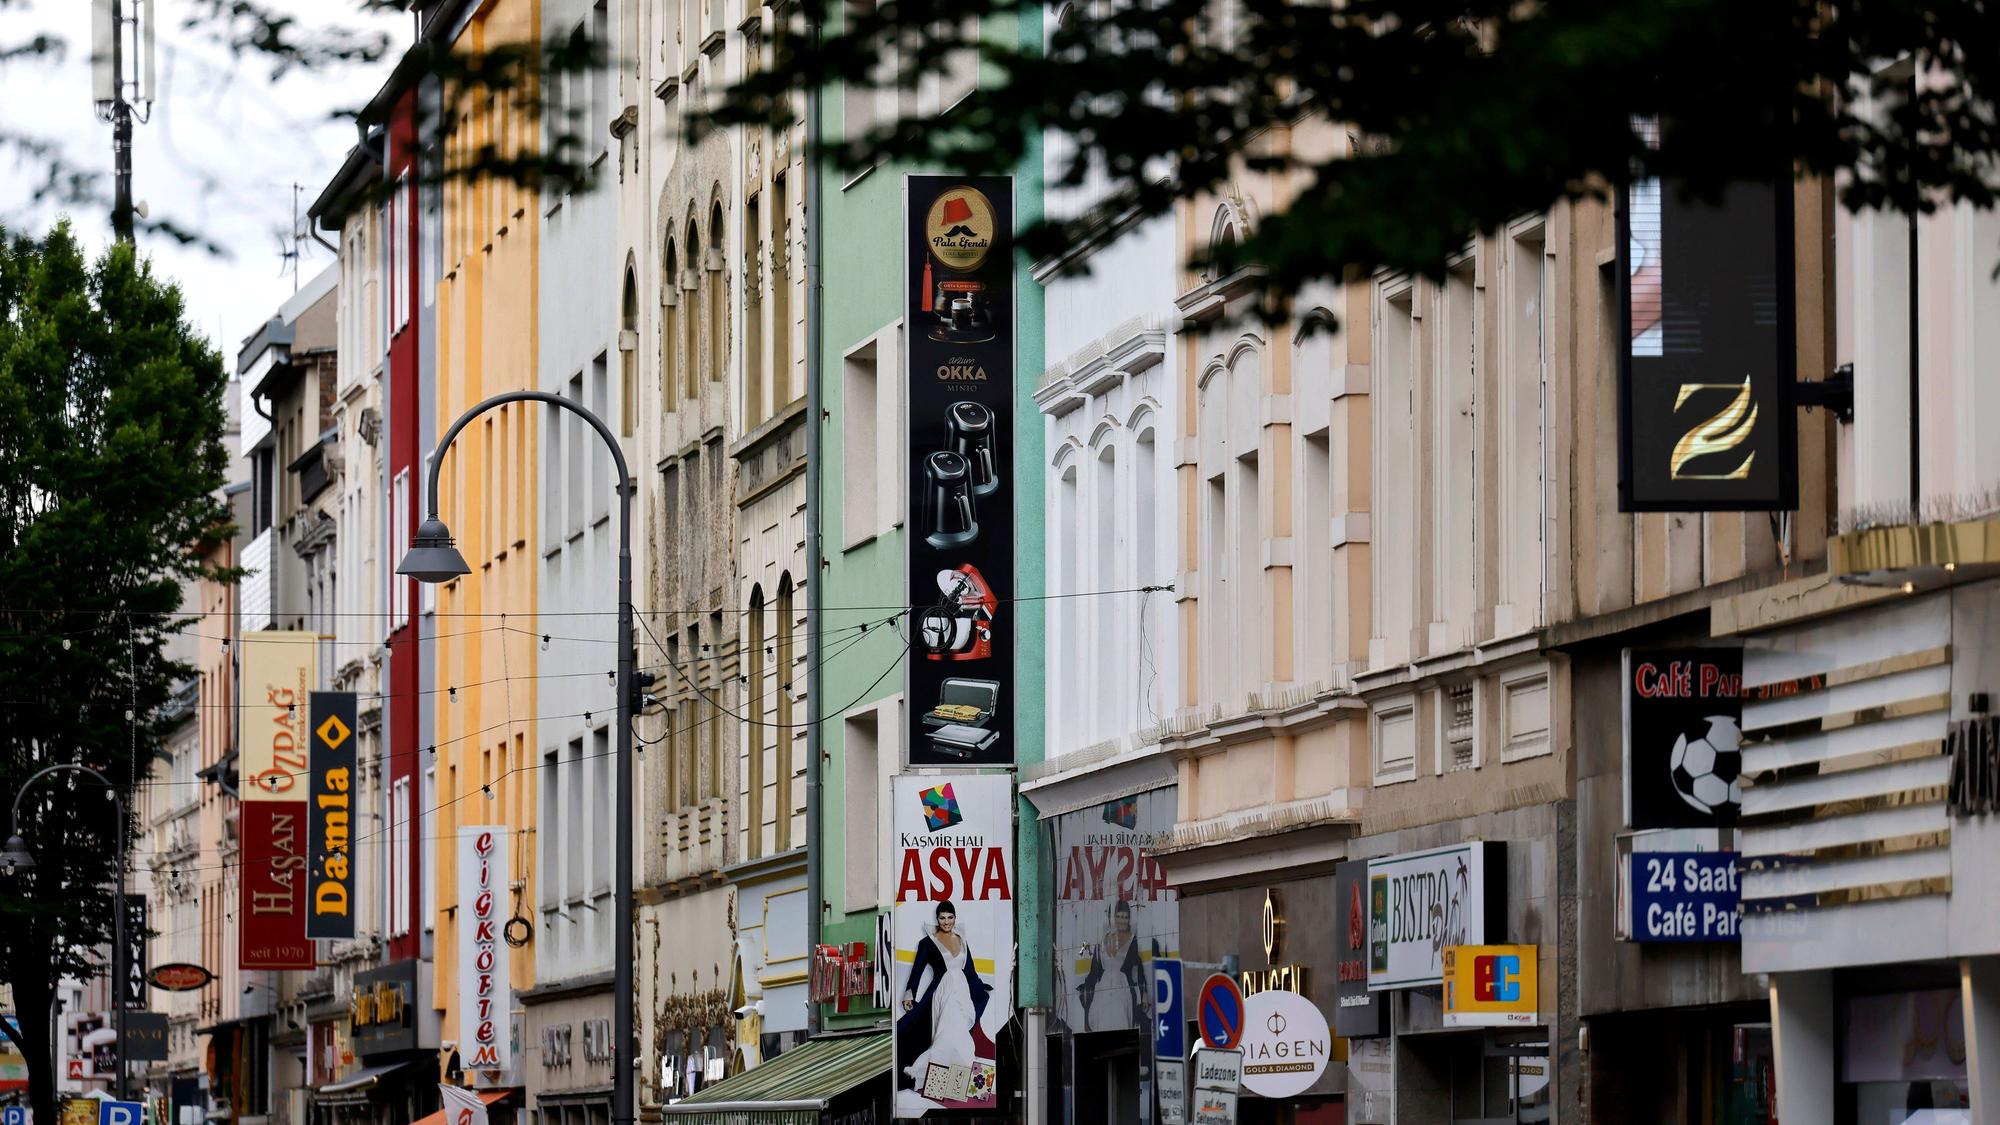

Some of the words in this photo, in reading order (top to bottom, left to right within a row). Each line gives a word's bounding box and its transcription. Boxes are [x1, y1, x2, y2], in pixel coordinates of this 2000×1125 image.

[933, 236, 956, 248] Pala
[958, 236, 988, 249] Efendi
[937, 365, 987, 380] OKKA
[316, 766, 349, 917] Damla
[956, 835, 983, 847] HALI
[896, 847, 1012, 902] ASYA
[1647, 858, 1676, 892] 24
[1683, 858, 1737, 892] Saat
[1391, 868, 1449, 943] BISTRO
[1647, 902, 1696, 937] Café
[250, 946, 271, 959] seit
[276, 946, 304, 959] 1970
[1201, 1062, 1237, 1082] Ladezone
[1245, 1066, 1267, 1074] GOLD
[1275, 1063, 1313, 1072] DIAMOND
[9, 1110, 20, 1125] P
[109, 1106, 132, 1125] P
